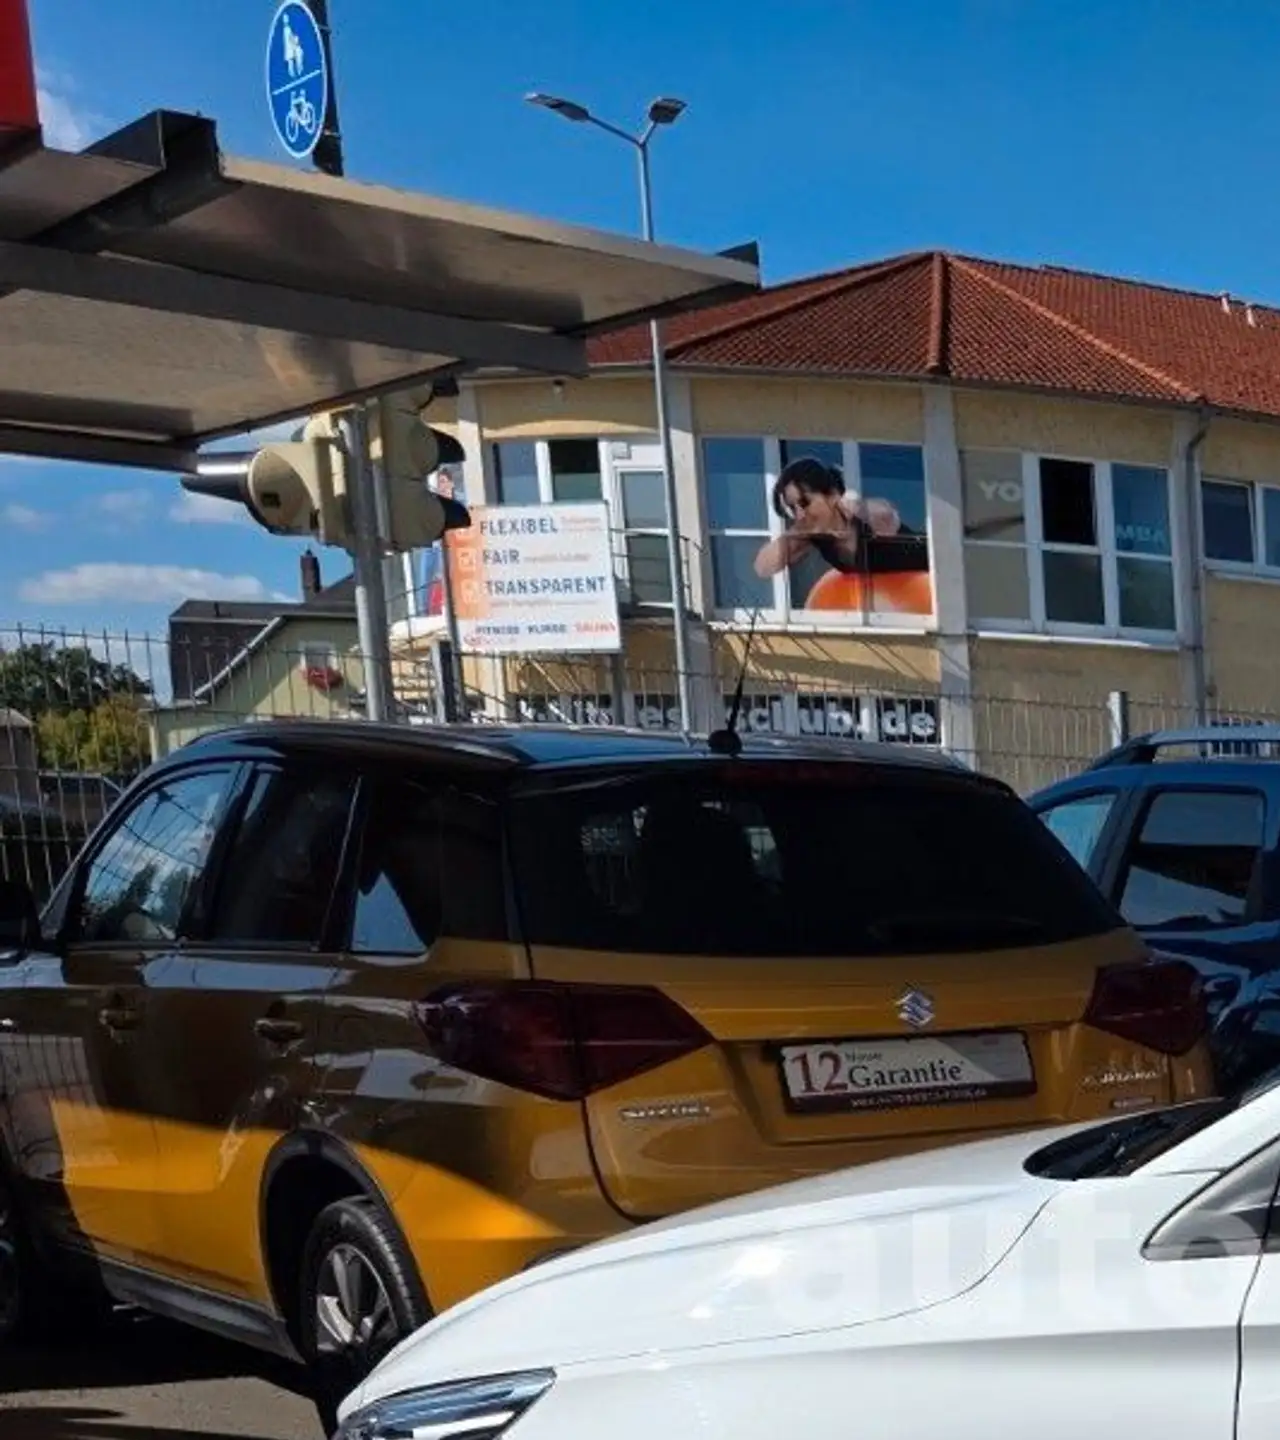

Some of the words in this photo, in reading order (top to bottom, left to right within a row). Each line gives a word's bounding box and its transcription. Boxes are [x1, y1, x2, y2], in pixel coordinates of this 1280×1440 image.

[480, 517, 558, 536] FLEXIBEL
[486, 576, 607, 596] TRANSPARENT
[790, 1050, 848, 1094] 12
[849, 1060, 964, 1088] Garantie
